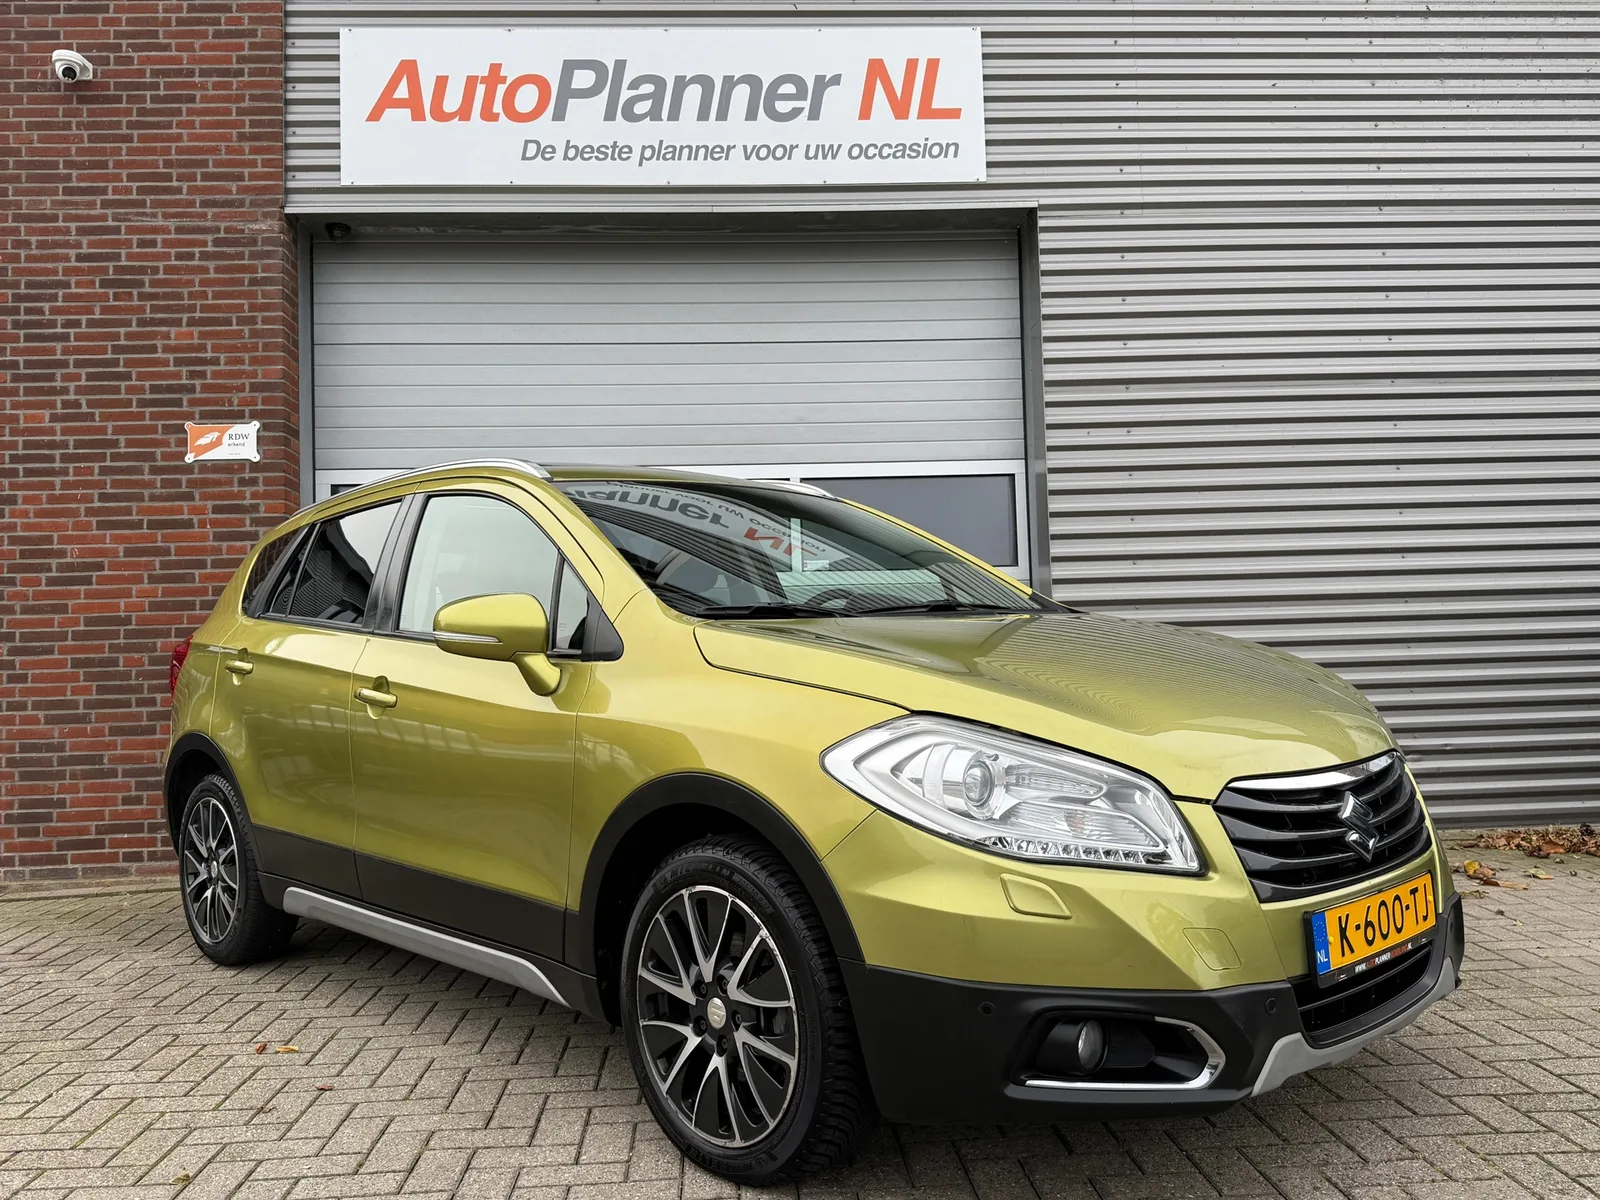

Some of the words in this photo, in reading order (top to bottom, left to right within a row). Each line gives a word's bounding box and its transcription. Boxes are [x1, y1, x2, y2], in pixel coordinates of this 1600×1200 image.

[365, 59, 842, 123] AutoPlanner
[858, 58, 962, 120] NL
[521, 139, 556, 161] De
[563, 139, 633, 161] beste
[638, 138, 736, 167] planner
[743, 142, 799, 160] voor
[805, 142, 842, 160] uw
[848, 138, 960, 160] occasion
[1338, 883, 1429, 957] K-600-TJ
[1316, 950, 1328, 964] NL
